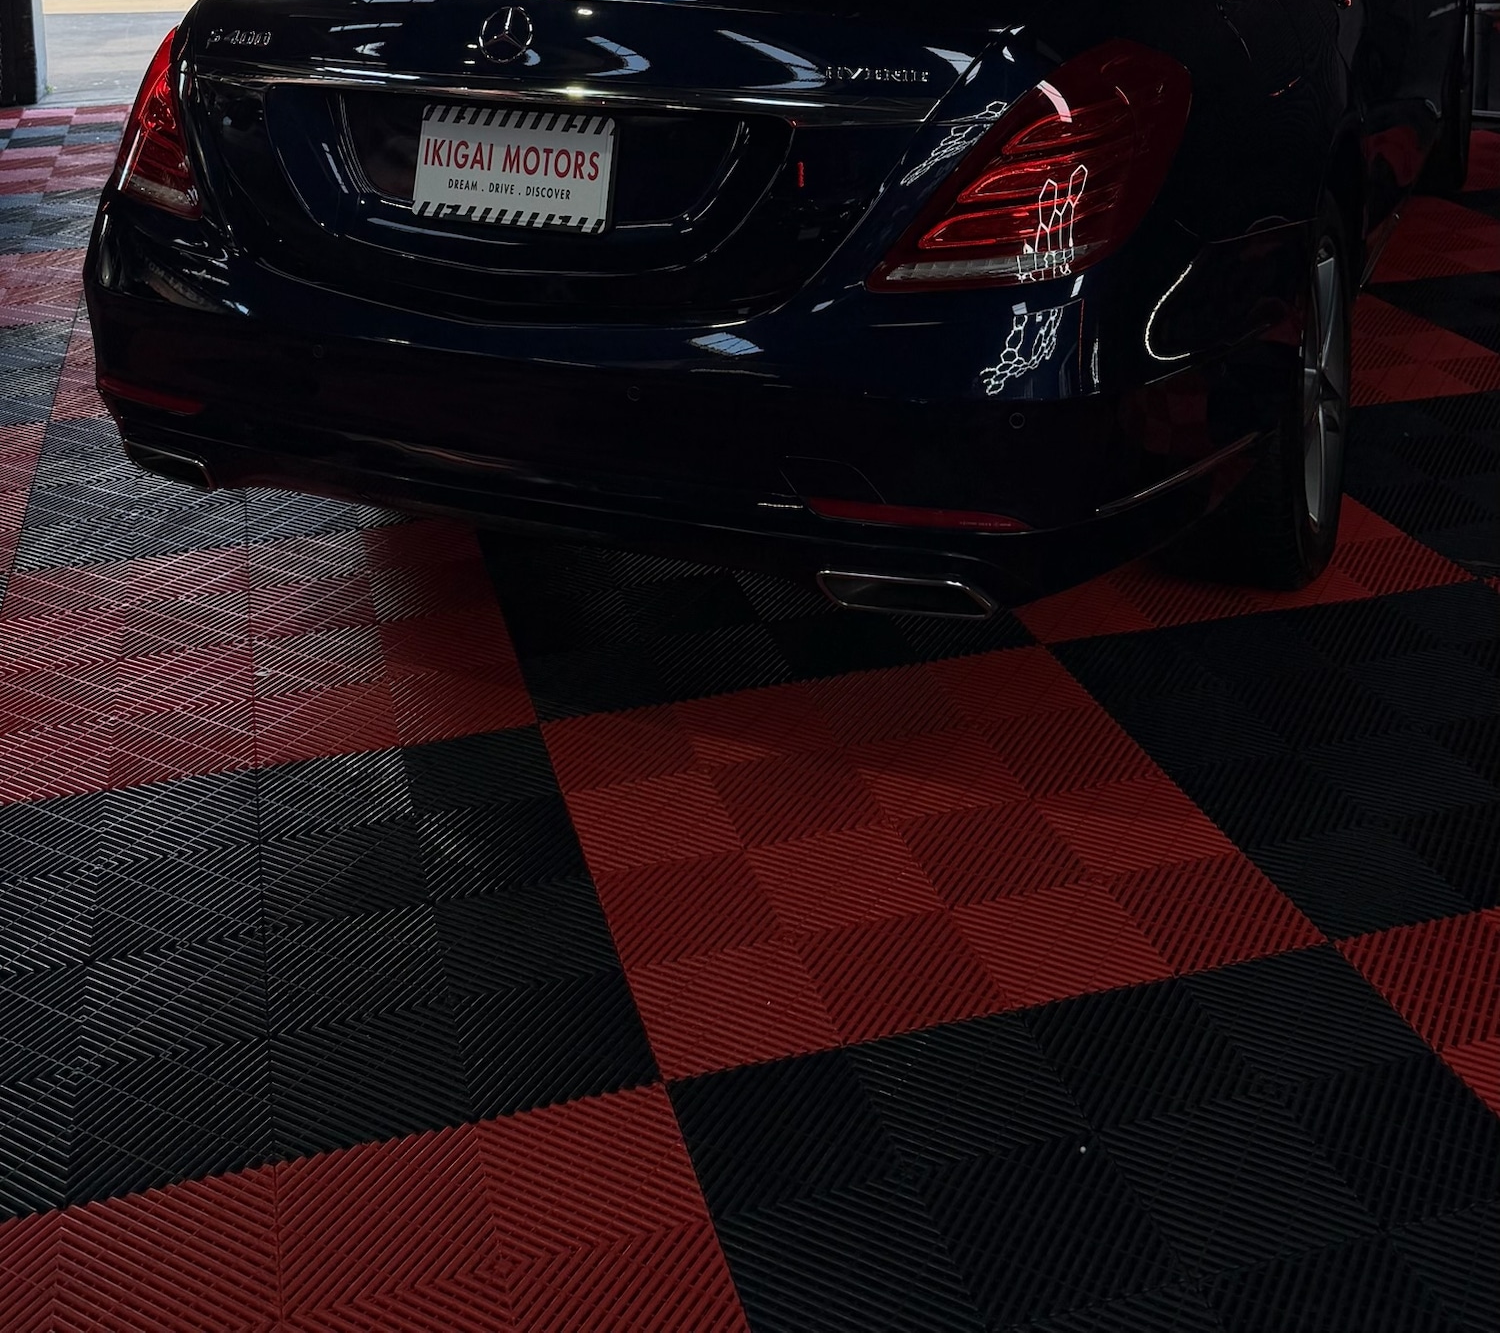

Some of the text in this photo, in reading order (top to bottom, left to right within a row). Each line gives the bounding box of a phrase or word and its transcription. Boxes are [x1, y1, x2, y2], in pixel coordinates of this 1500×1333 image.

[423, 138, 600, 182] IKIGAI MOTORS
[448, 178, 571, 201] DREAM DRIVE DISCOVER
